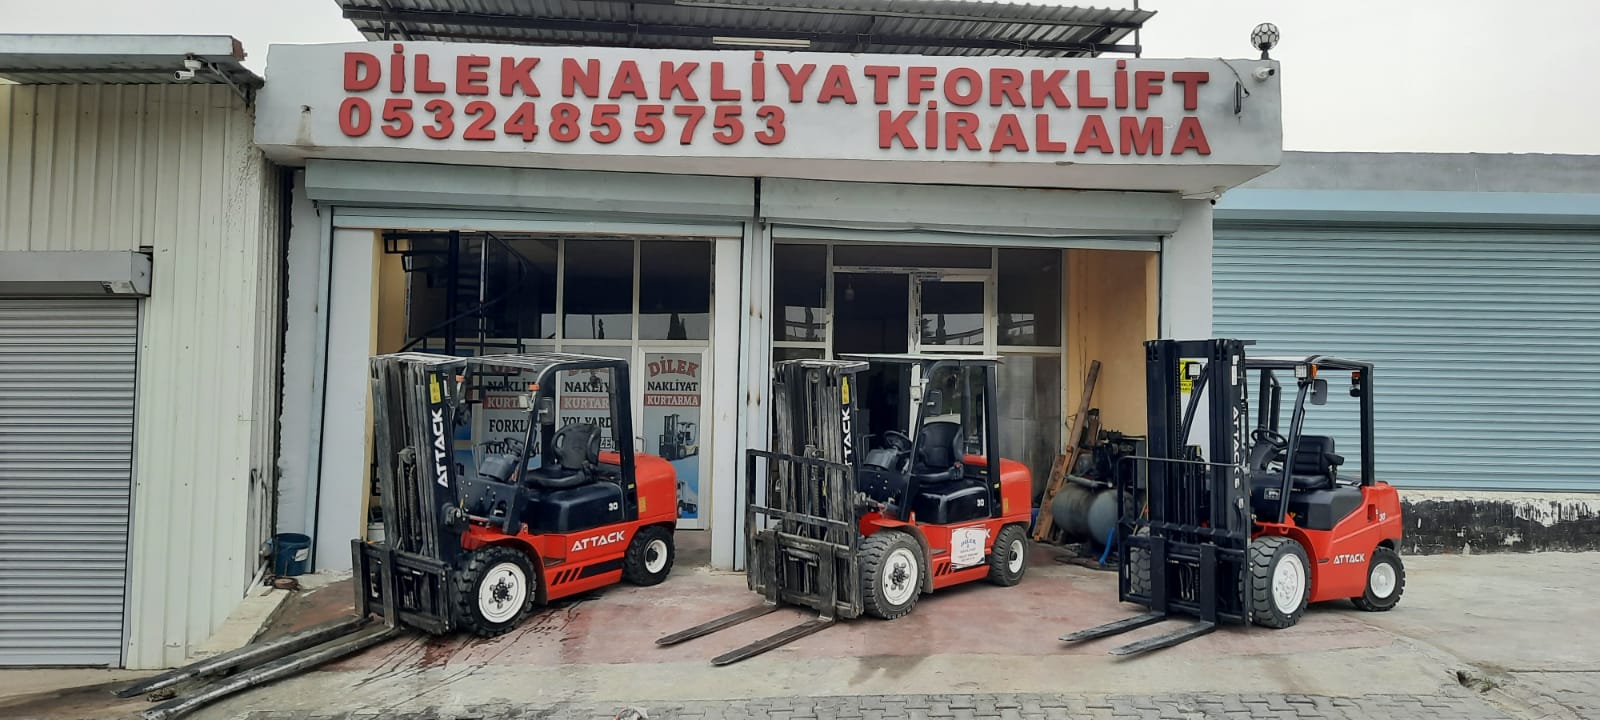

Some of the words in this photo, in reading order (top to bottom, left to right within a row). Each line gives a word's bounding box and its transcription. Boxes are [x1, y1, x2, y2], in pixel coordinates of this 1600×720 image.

[344, 44, 540, 98] DİLEK
[339, 97, 786, 145] 05324855753
[880, 100, 1211, 155] KİRALAMA
[648, 355, 699, 377] DİLEK
[647, 379, 698, 391] NAKLİYAT
[647, 395, 698, 406] KURTARMA
[432, 408, 448, 488] ATTACK
[608, 502, 619, 511] 30
[571, 531, 625, 552] ATTACK
[1333, 553, 1366, 565] ATTACK
